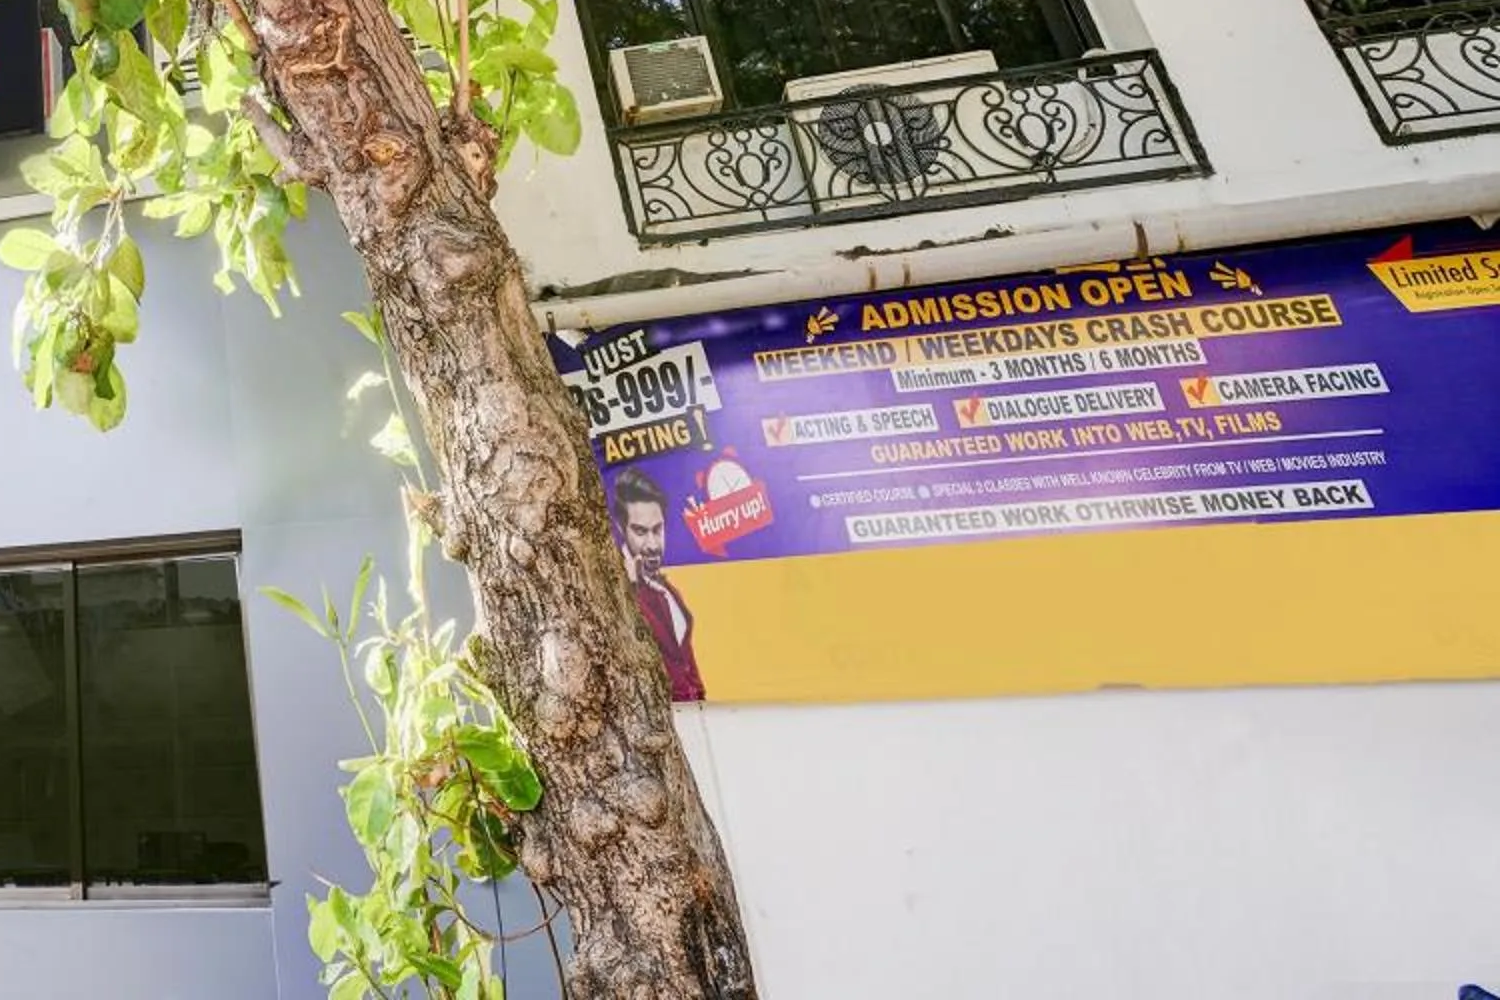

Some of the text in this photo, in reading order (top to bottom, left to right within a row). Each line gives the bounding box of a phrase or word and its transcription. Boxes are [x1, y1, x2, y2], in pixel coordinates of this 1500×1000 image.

[1388, 255, 1500, 288] Limited S
[861, 270, 1193, 331] ADMISSION OPEN
[583, 329, 648, 377] JUST
[757, 341, 897, 378] WEEKEND
[917, 322, 1080, 361] WEEKDAYS
[1086, 311, 1194, 344] CRASH
[1201, 297, 1338, 333] COURSE
[897, 369, 977, 389] Minimum
[991, 362, 1002, 380] 3
[1005, 354, 1087, 379] MONTHS
[1101, 350, 1113, 369] 6
[1114, 341, 1201, 367] MONTHS
[1218, 368, 1382, 401] CAMERA FACING
[793, 417, 852, 439] ACTING
[871, 409, 935, 431] SPEECH
[987, 387, 1157, 421] DIALOGUE DELIVERY
[870, 434, 1001, 464] GUARANTEED
[1007, 429, 1069, 453] WORK
[1071, 423, 1122, 446] INTO
[1214, 411, 1282, 435] FILMS
[1032, 475, 1059, 490] WITH
[1090, 467, 1132, 484] KNOWN
[1133, 462, 1192, 482] CELEBRITY
[1195, 460, 1226, 477] FROM
[1228, 459, 1243, 474] TV
[1250, 456, 1276, 472] WEB
[1328, 449, 1387, 468] INDUSTRY
[697, 491, 767, 537] Hurry up!
[853, 483, 1365, 538] GUARANTEED WORK OTHRWISE MONEY BACK
